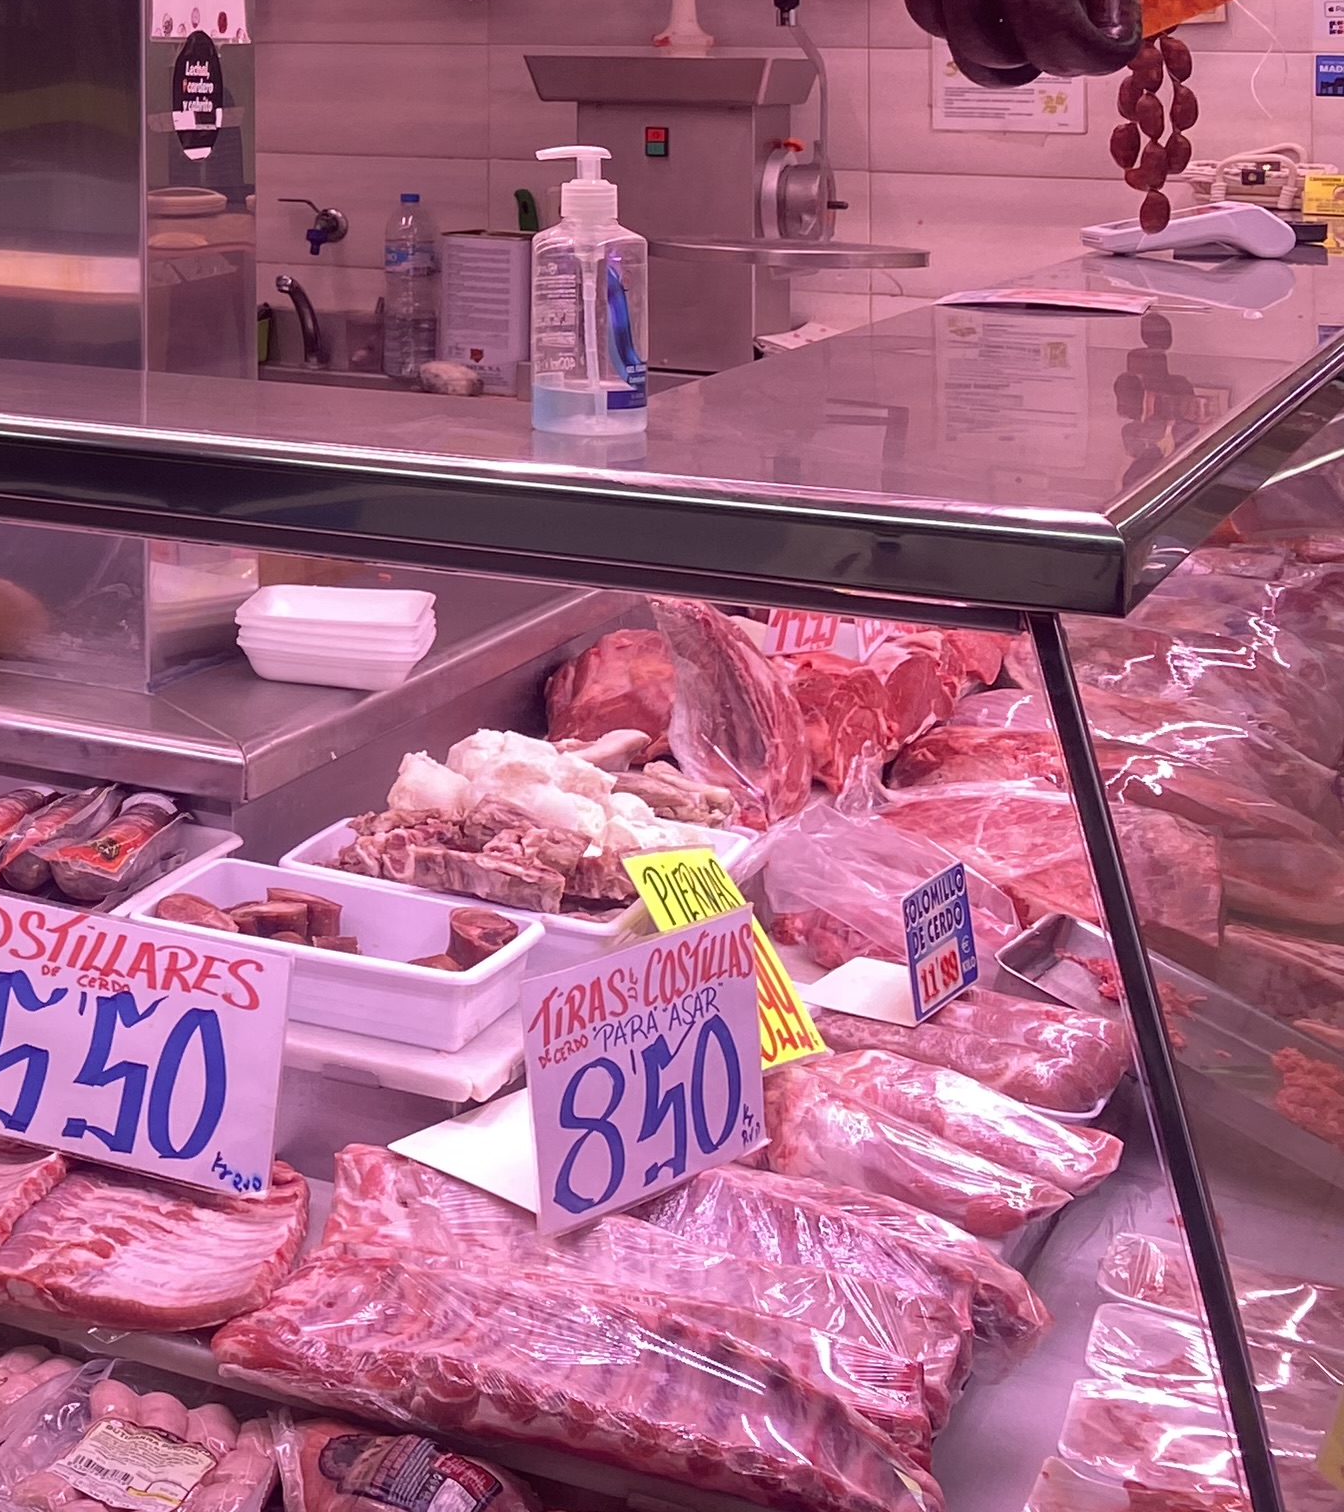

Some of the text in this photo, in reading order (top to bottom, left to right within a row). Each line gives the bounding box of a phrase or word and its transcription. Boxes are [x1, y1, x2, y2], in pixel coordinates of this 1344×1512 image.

[643, 858, 742, 927] PIERNAS
[904, 868, 965, 931] SOLOMILLO
[912, 901, 963, 958] DE CERDO
[41, 963, 132, 994] DE CERDO
[527, 967, 630, 1049] TIRAS
[643, 922, 756, 1009] COSTILLAS
[538, 1047, 553, 1070] DE
[553, 1034, 589, 1065] CERDO
[552, 1013, 742, 1214] 8'50
